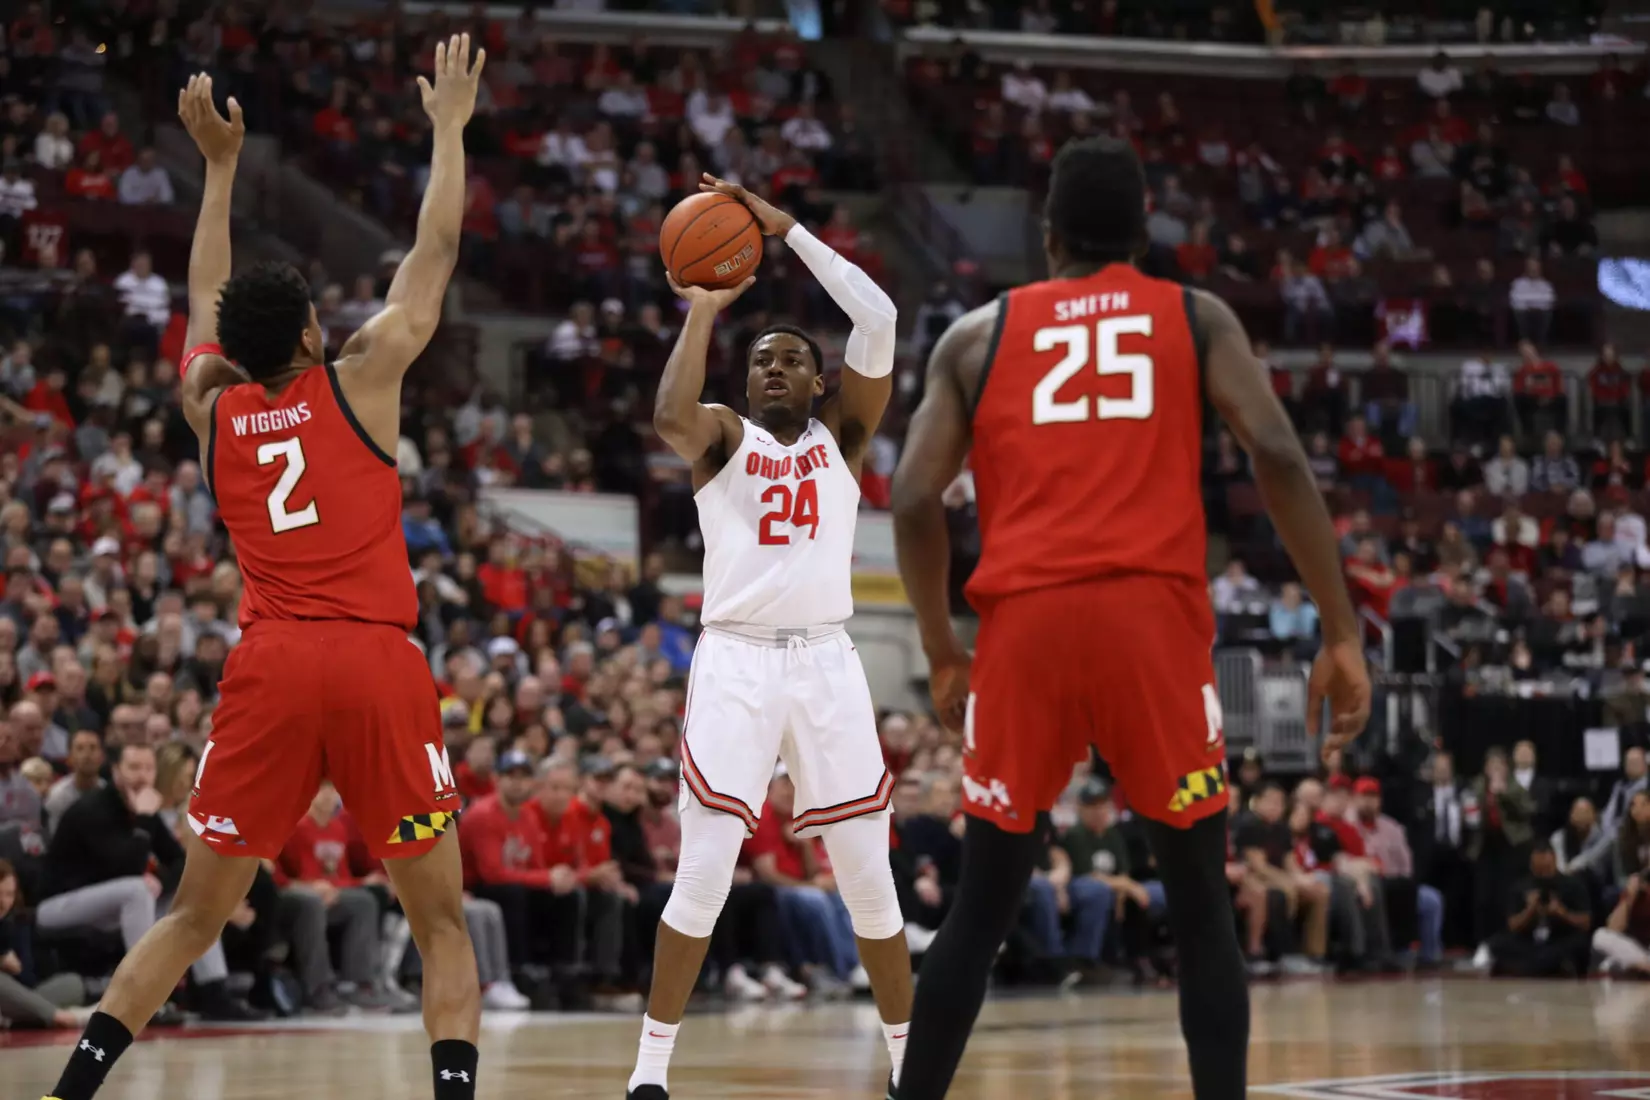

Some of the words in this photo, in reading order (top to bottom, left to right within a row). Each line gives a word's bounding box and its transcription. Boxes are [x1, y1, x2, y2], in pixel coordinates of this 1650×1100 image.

[1054, 291, 1129, 321] SMITH
[1033, 314, 1153, 424] 25
[232, 401, 312, 436] WIGGINS
[257, 436, 320, 534] 2
[745, 451, 792, 480] OHIO
[794, 444, 829, 480] ATE
[758, 479, 820, 545] 24
[424, 742, 456, 792] M
